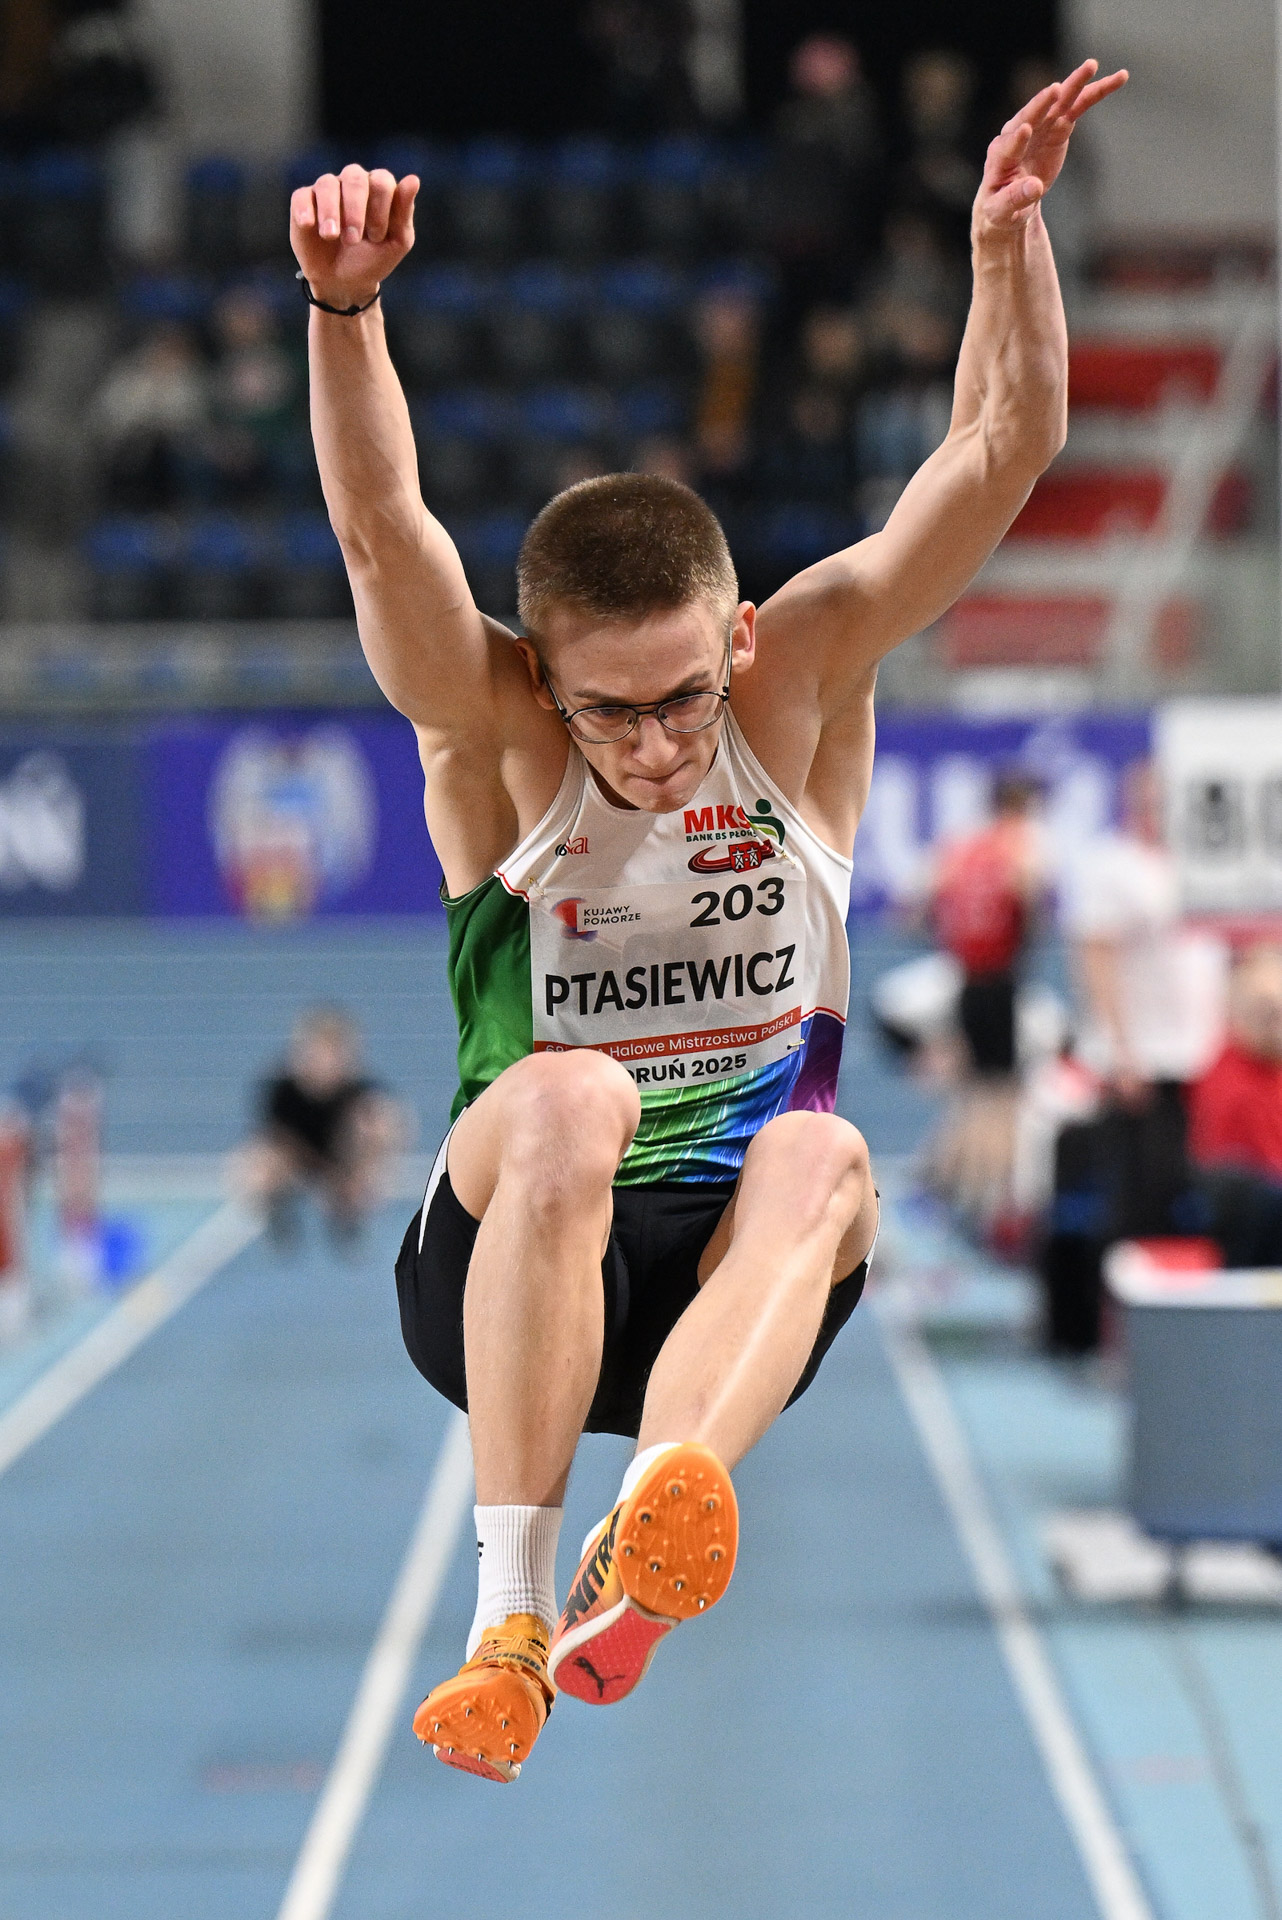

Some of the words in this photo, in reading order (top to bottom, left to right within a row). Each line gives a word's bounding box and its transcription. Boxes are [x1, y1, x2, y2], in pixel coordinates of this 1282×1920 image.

[683, 804, 752, 834] MKS
[686, 832, 713, 842] BANK
[715, 831, 727, 840] BS
[583, 905, 631, 917] KUJAWY
[690, 877, 785, 928] 203
[583, 913, 642, 926] POMORZE
[545, 943, 797, 1018] PTASIEWICZ
[610, 1042, 665, 1057] Halowe
[669, 1030, 757, 1051] Mistrzostwa
[761, 1012, 794, 1037] Polski
[627, 1057, 686, 1084] RUŃ
[691, 1053, 747, 1077] 2025
